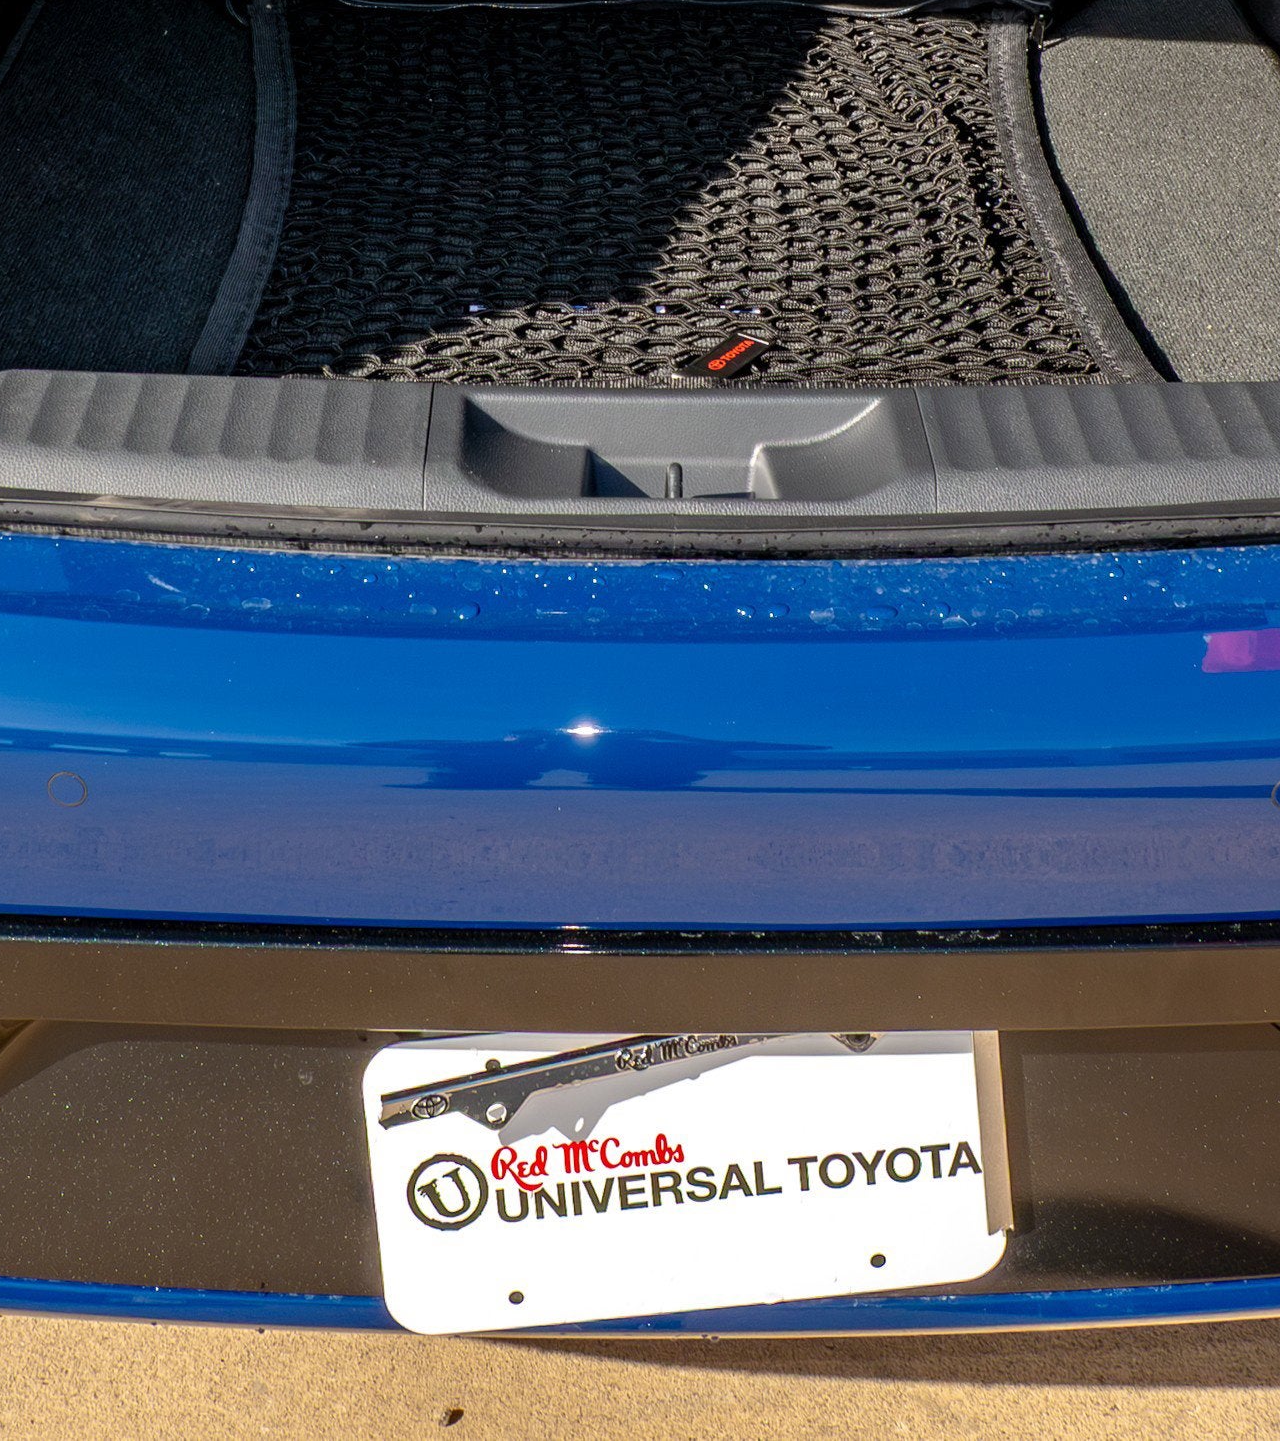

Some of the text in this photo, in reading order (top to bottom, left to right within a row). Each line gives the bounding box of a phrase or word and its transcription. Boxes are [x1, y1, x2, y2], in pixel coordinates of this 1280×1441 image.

[719, 339, 755, 362] TOYOTA
[614, 1034, 739, 1071] Red McCombs
[490, 1133, 685, 1192] Red McCombs
[495, 1141, 983, 1223] UNIVERSAL TOYOTA
